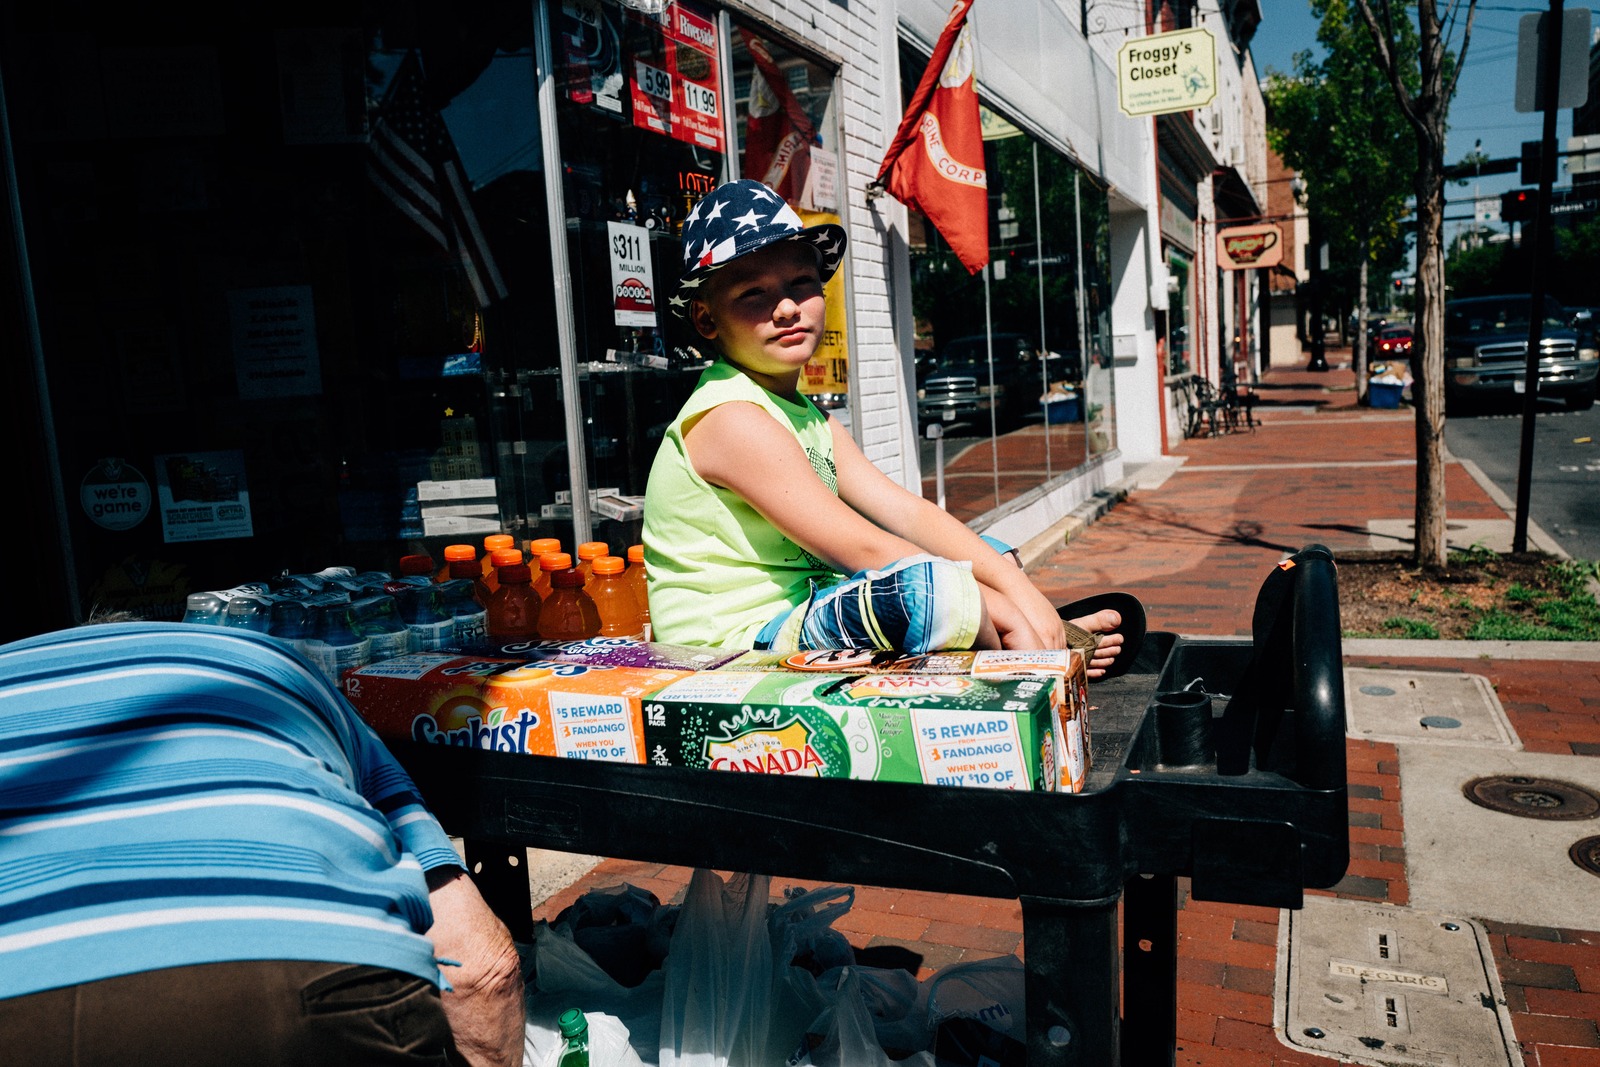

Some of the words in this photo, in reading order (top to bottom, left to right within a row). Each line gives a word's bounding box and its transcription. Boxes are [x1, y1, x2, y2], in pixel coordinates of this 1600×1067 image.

[679, 13, 716, 49] Riverside
[1129, 41, 1192, 62] Froggy's
[1130, 63, 1178, 81] Closet
[645, 68, 671, 100] 5.99
[686, 83, 715, 114] 11.99
[924, 115, 940, 149] RINE
[938, 157, 983, 182] CORP
[613, 234, 641, 261] $311
[619, 263, 646, 274] MILLION
[616, 285, 646, 299] POWER
[94, 485, 138, 500] we're
[93, 502, 142, 518] game
[568, 647, 613, 655] Grape
[346, 677, 361, 693] 12
[556, 708, 568, 718] $5
[571, 703, 623, 717] REWARD
[645, 704, 666, 720] 12
[572, 723, 625, 735] FANDANGO
[879, 728, 903, 738] Ginger
[922, 727, 937, 740] $5
[940, 720, 1009, 739] REWARD
[567, 750, 588, 760] BUY
[591, 748, 608, 758] $10
[611, 747, 626, 757] OF
[737, 743, 757, 753] SINCE
[943, 743, 1012, 759] FANDANGO
[947, 764, 976, 773] WHEN
[978, 762, 998, 770] YOU
[936, 775, 964, 786] BUY
[969, 773, 990, 784] $10
[993, 770, 1014, 782] OF
[1337, 965, 1440, 988] ELECTRIC
